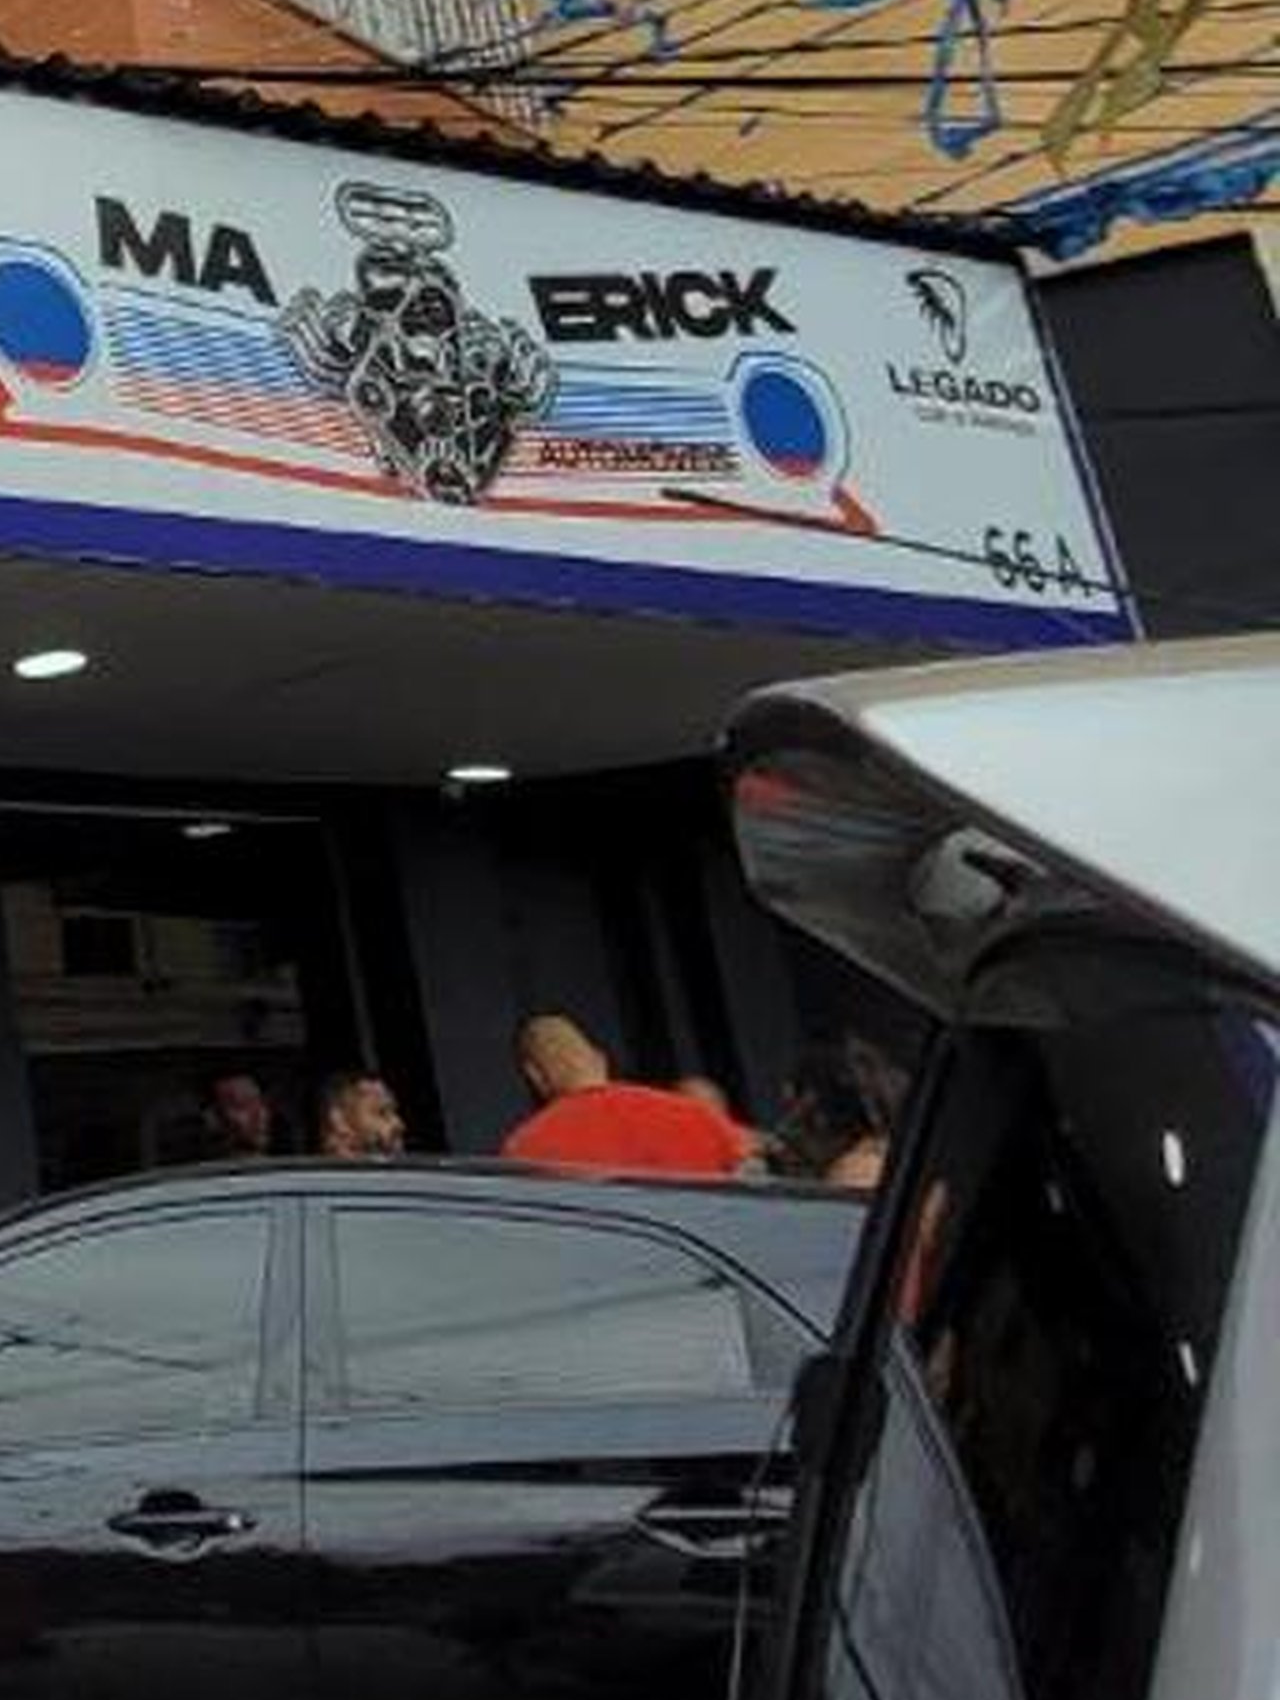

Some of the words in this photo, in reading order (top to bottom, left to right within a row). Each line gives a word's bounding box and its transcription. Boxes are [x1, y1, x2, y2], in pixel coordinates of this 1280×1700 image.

[93, 196, 279, 307] MA
[528, 267, 797, 343] ERICK
[886, 360, 1041, 413] LEGADO
[983, 527, 1045, 592] 66
